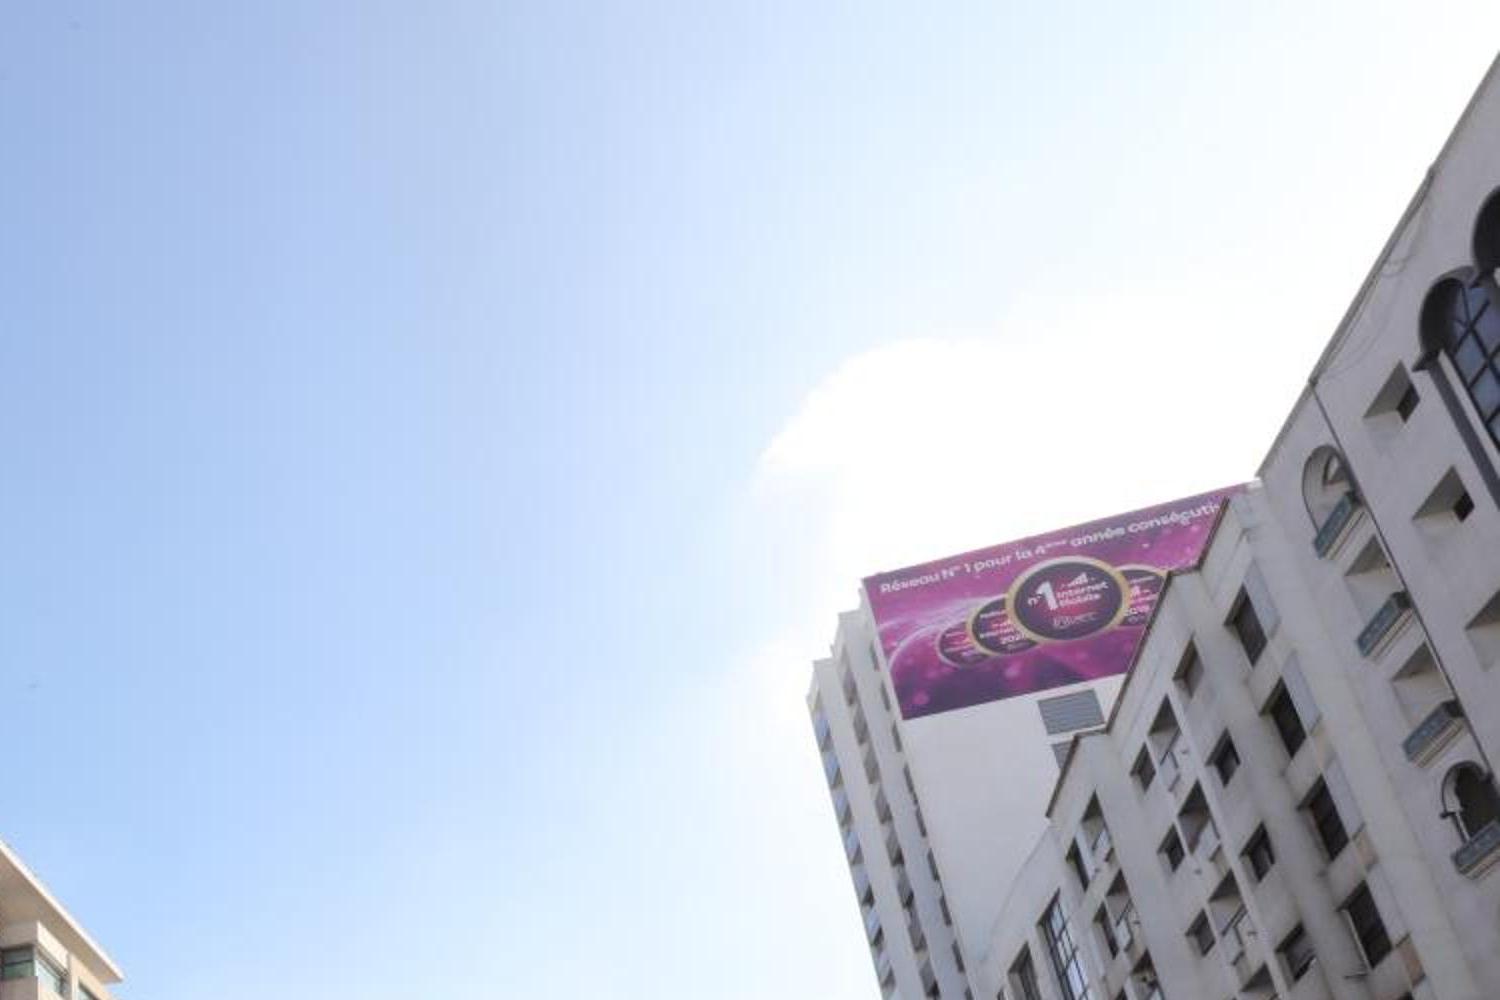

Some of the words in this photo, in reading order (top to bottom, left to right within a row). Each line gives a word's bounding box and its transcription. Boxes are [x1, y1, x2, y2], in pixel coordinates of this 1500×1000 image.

[973, 555, 1013, 574] pour
[1015, 549, 1032, 561] la
[1070, 525, 1126, 547] année
